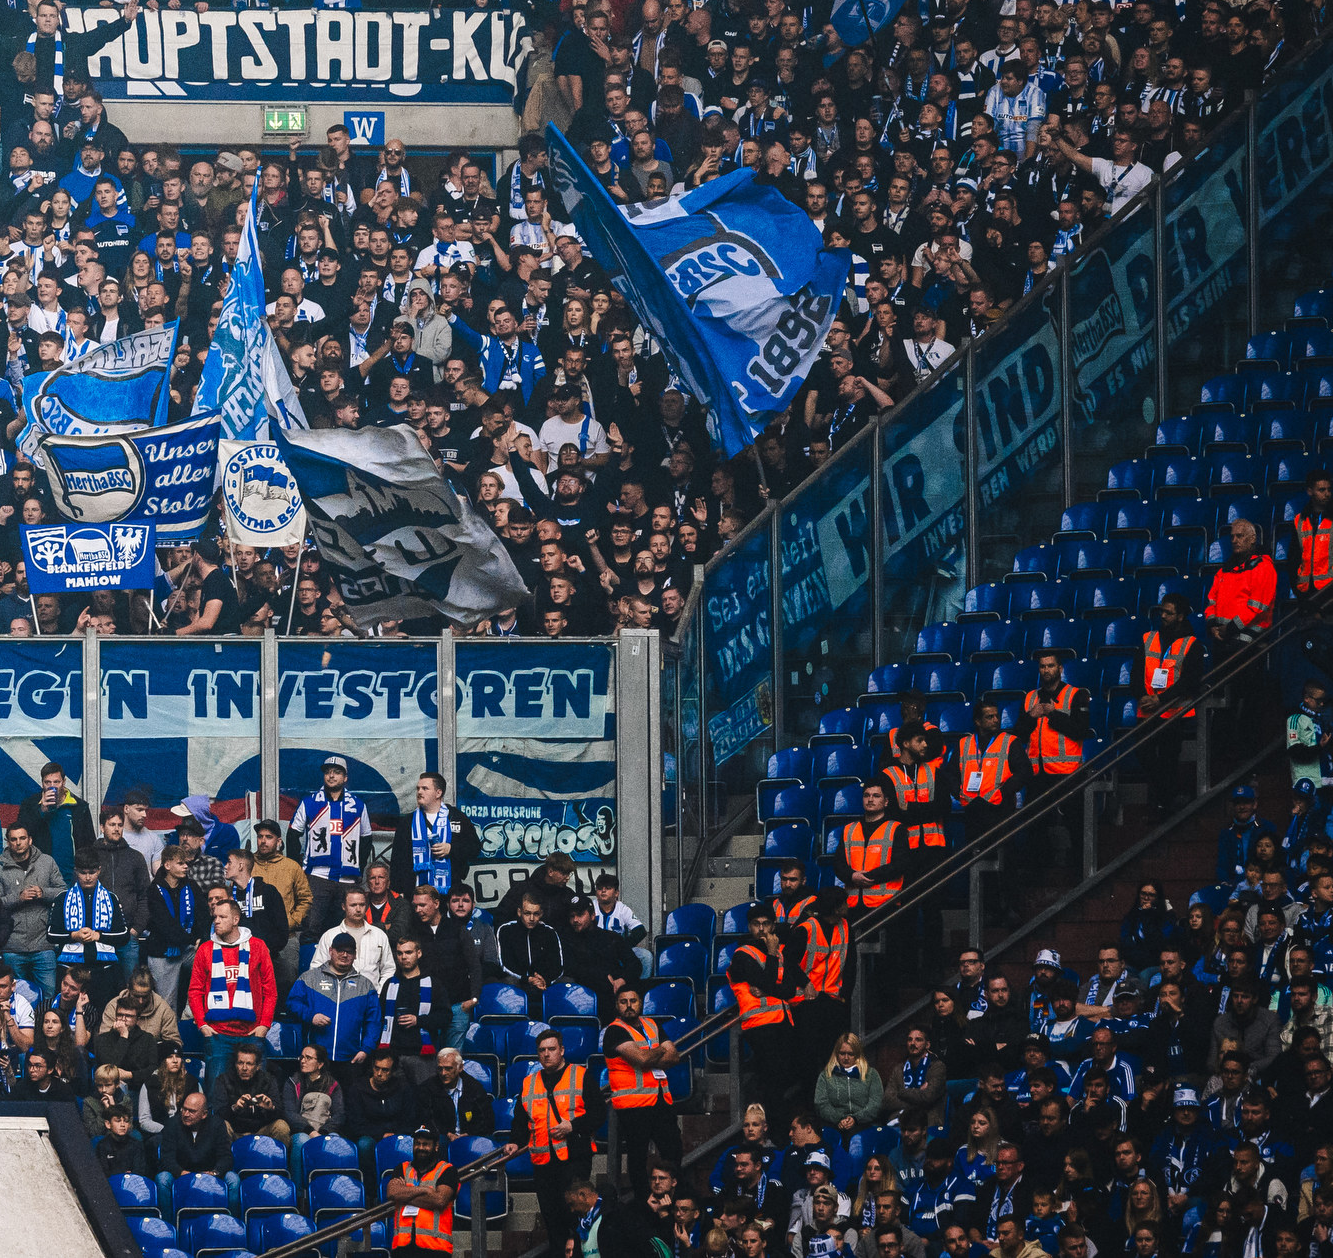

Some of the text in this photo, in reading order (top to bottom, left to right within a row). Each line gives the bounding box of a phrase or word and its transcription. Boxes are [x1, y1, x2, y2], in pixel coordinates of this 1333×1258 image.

[351, 116, 378, 139] W
[750, 289, 832, 392] 1892
[144, 441, 216, 464] Unser
[65, 471, 131, 491] HerthaBSC
[155, 463, 213, 489] aller
[227, 494, 275, 529] HERTHA
[278, 495, 302, 525] BSC
[46, 560, 132, 574] BLANKENFELDE
[65, 574, 122, 588] MAHLOW
[188, 668, 595, 720] INVESTOREN
[490, 805, 542, 819] KARLSRUHE
